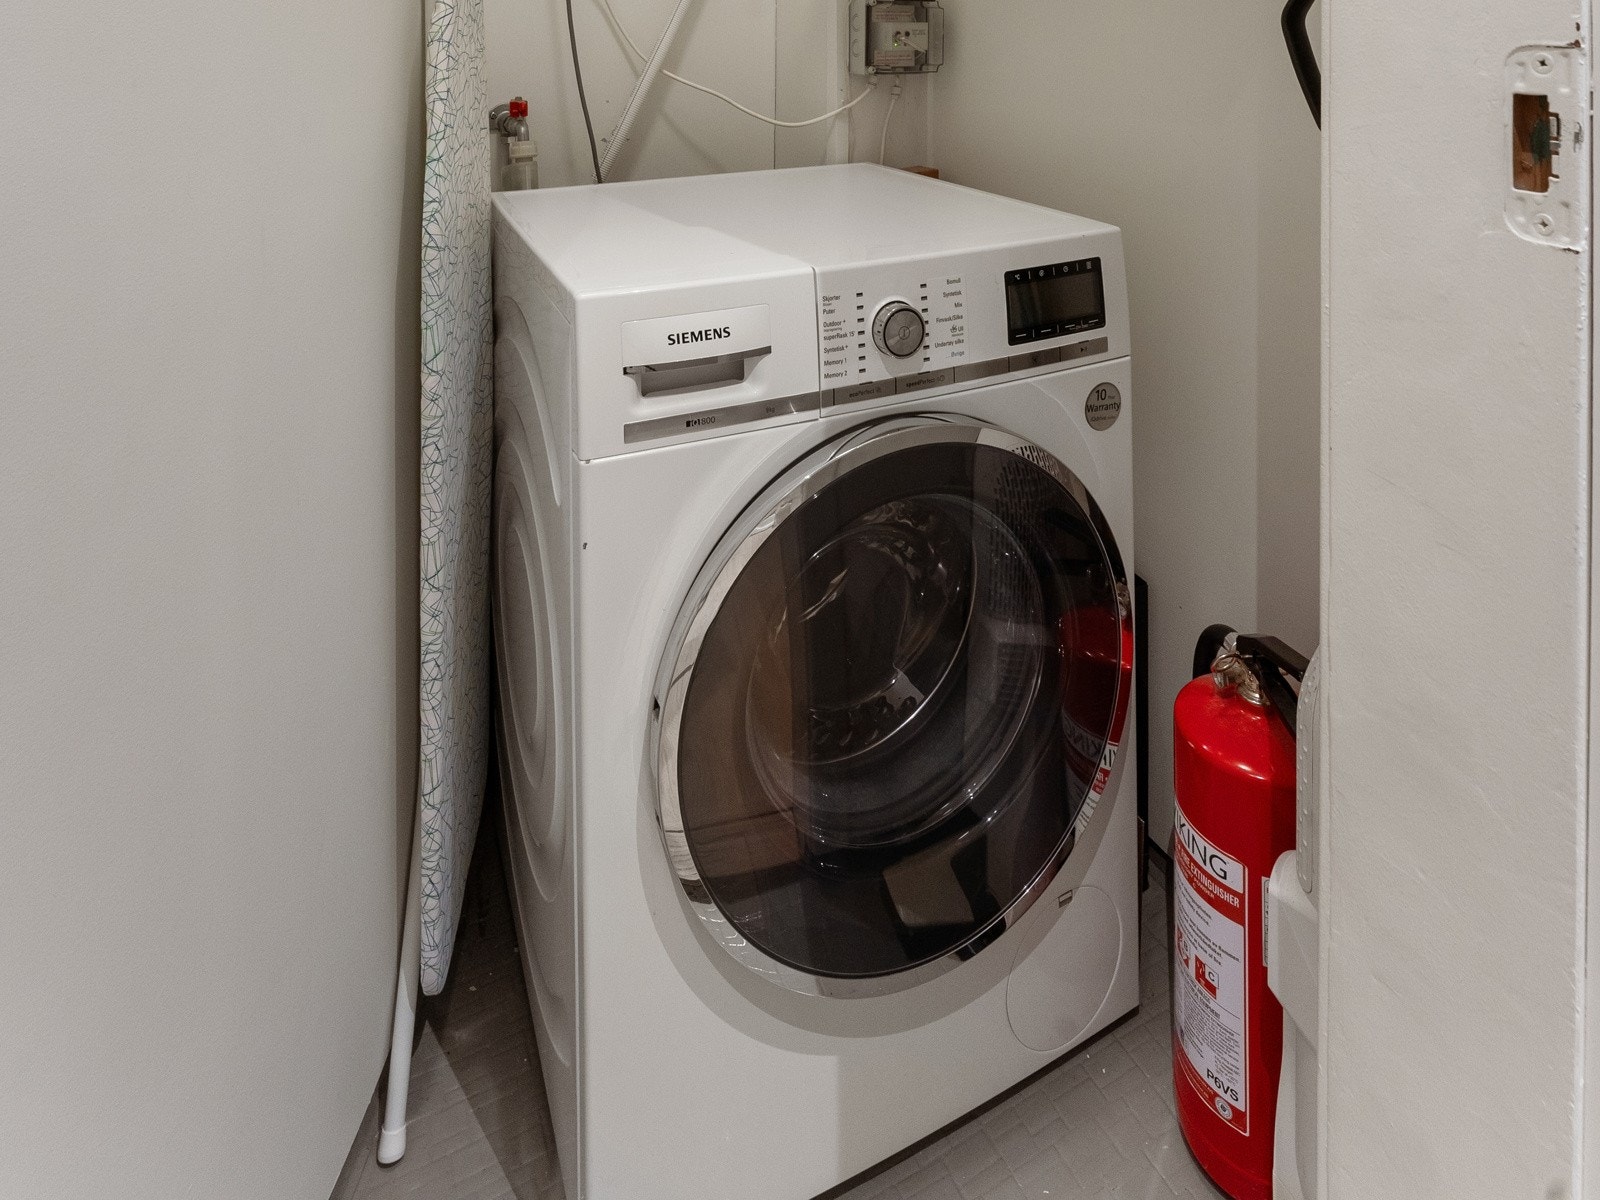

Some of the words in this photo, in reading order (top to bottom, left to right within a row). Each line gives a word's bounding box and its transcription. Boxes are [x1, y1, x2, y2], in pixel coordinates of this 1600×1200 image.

[823, 320, 842, 328] Outdoor
[667, 327, 731, 346] SIEMENS
[823, 358, 843, 367] Memory
[823, 370, 843, 379] Memory
[1095, 388, 1107, 401] 10
[1086, 402, 1121, 413] Warranty
[1190, 862, 1239, 908] EXTINGUISHER
[1208, 970, 1215, 983] C
[1206, 1068, 1239, 1102] P6VS
